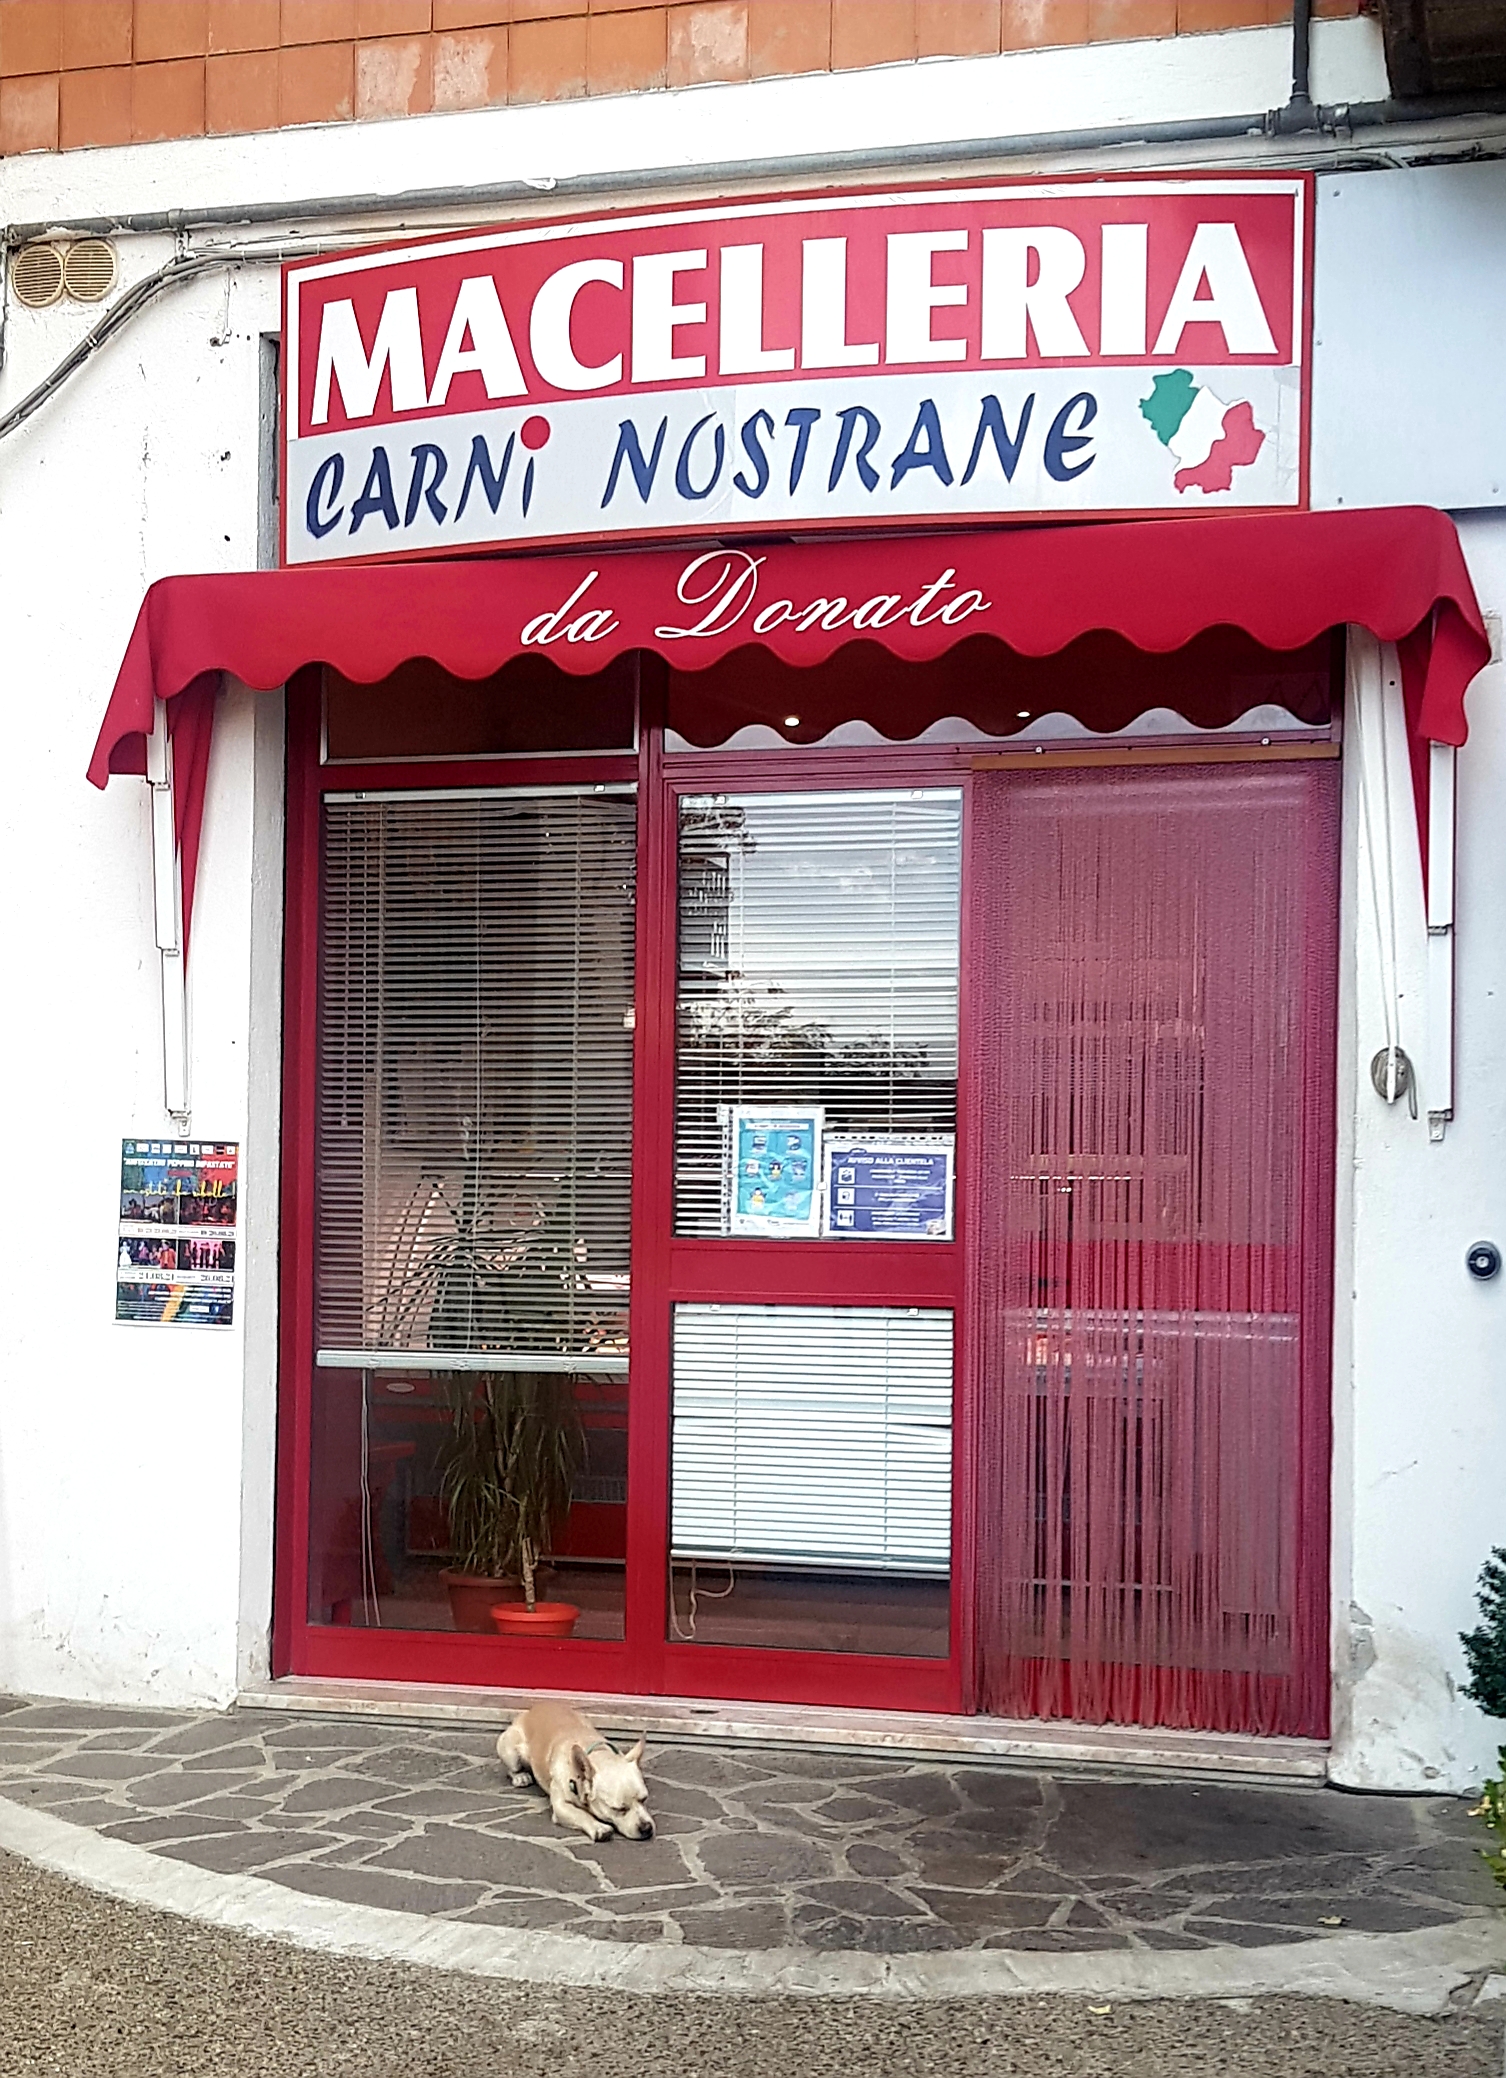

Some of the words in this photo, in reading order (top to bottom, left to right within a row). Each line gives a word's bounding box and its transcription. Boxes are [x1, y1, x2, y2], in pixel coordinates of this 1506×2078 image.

[311, 223, 1279, 424] MACELLERIA
[521, 571, 620, 645] da
[655, 550, 992, 638] Donato
[875, 1157, 894, 1165] ALLA
[895, 1157, 934, 1166] CLIENTELA
